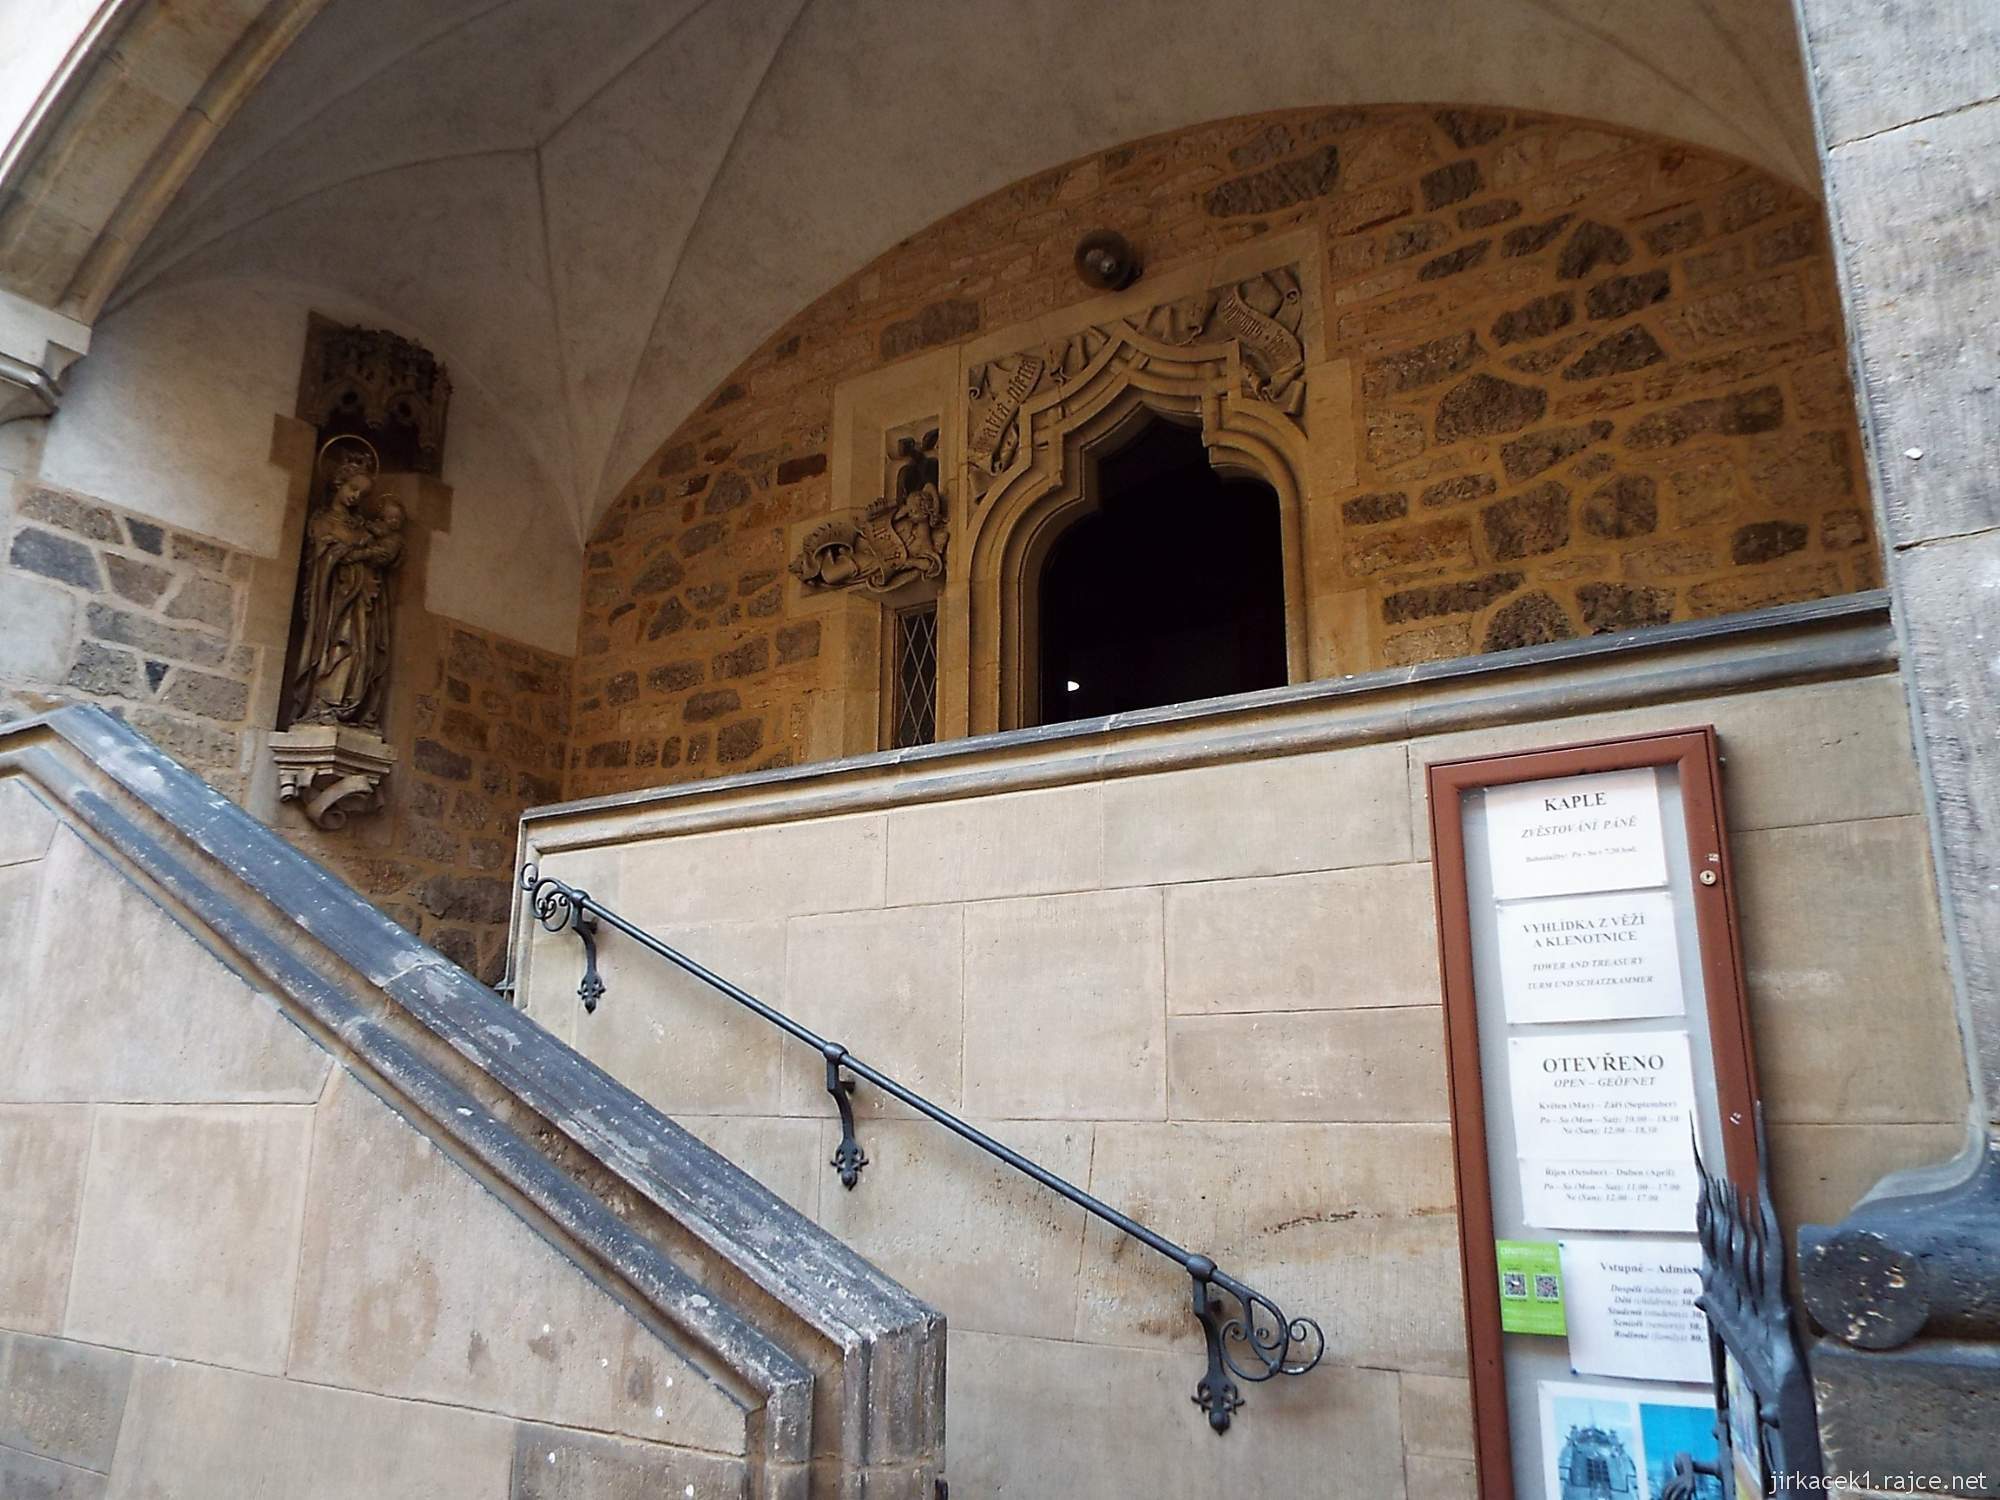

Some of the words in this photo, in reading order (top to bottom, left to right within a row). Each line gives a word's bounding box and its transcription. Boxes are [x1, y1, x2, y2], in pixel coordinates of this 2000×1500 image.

[1544, 792, 1608, 812] KAPLE
[1521, 820, 1598, 839] ZVĚSTOVÁNÍ
[1603, 815, 1638, 830] PÁNĚ
[1523, 919, 1595, 933] VYHLÍDKA
[1599, 917, 1608, 928] Z
[1611, 912, 1646, 926] VĚŽÍ
[1535, 938, 1542, 948] A
[1546, 931, 1638, 947] KLENOTNICE
[1533, 961, 1566, 971] TOWER
[1570, 960, 1589, 969] AND
[1592, 957, 1643, 968] TREASURY
[1528, 981, 1553, 990] TURM
[1554, 979, 1574, 988] UND
[1575, 975, 1654, 987] SCHATZKAMMER
[1543, 1052, 1664, 1073] OTEVŘENO
[1553, 1078, 1585, 1088] OPEN
[1539, 1101, 1567, 1110] Květen
[1569, 1101, 1594, 1110] (May)
[1624, 1101, 1677, 1111] (September)
[1540, 1116, 1551, 1124] Po
[1568, 1168, 1607, 1176] (October)
[1616, 1168, 1643, 1176] Duben
[1600, 1262, 1643, 1274] Vstupné
[1659, 1264, 1696, 1274] Admis
